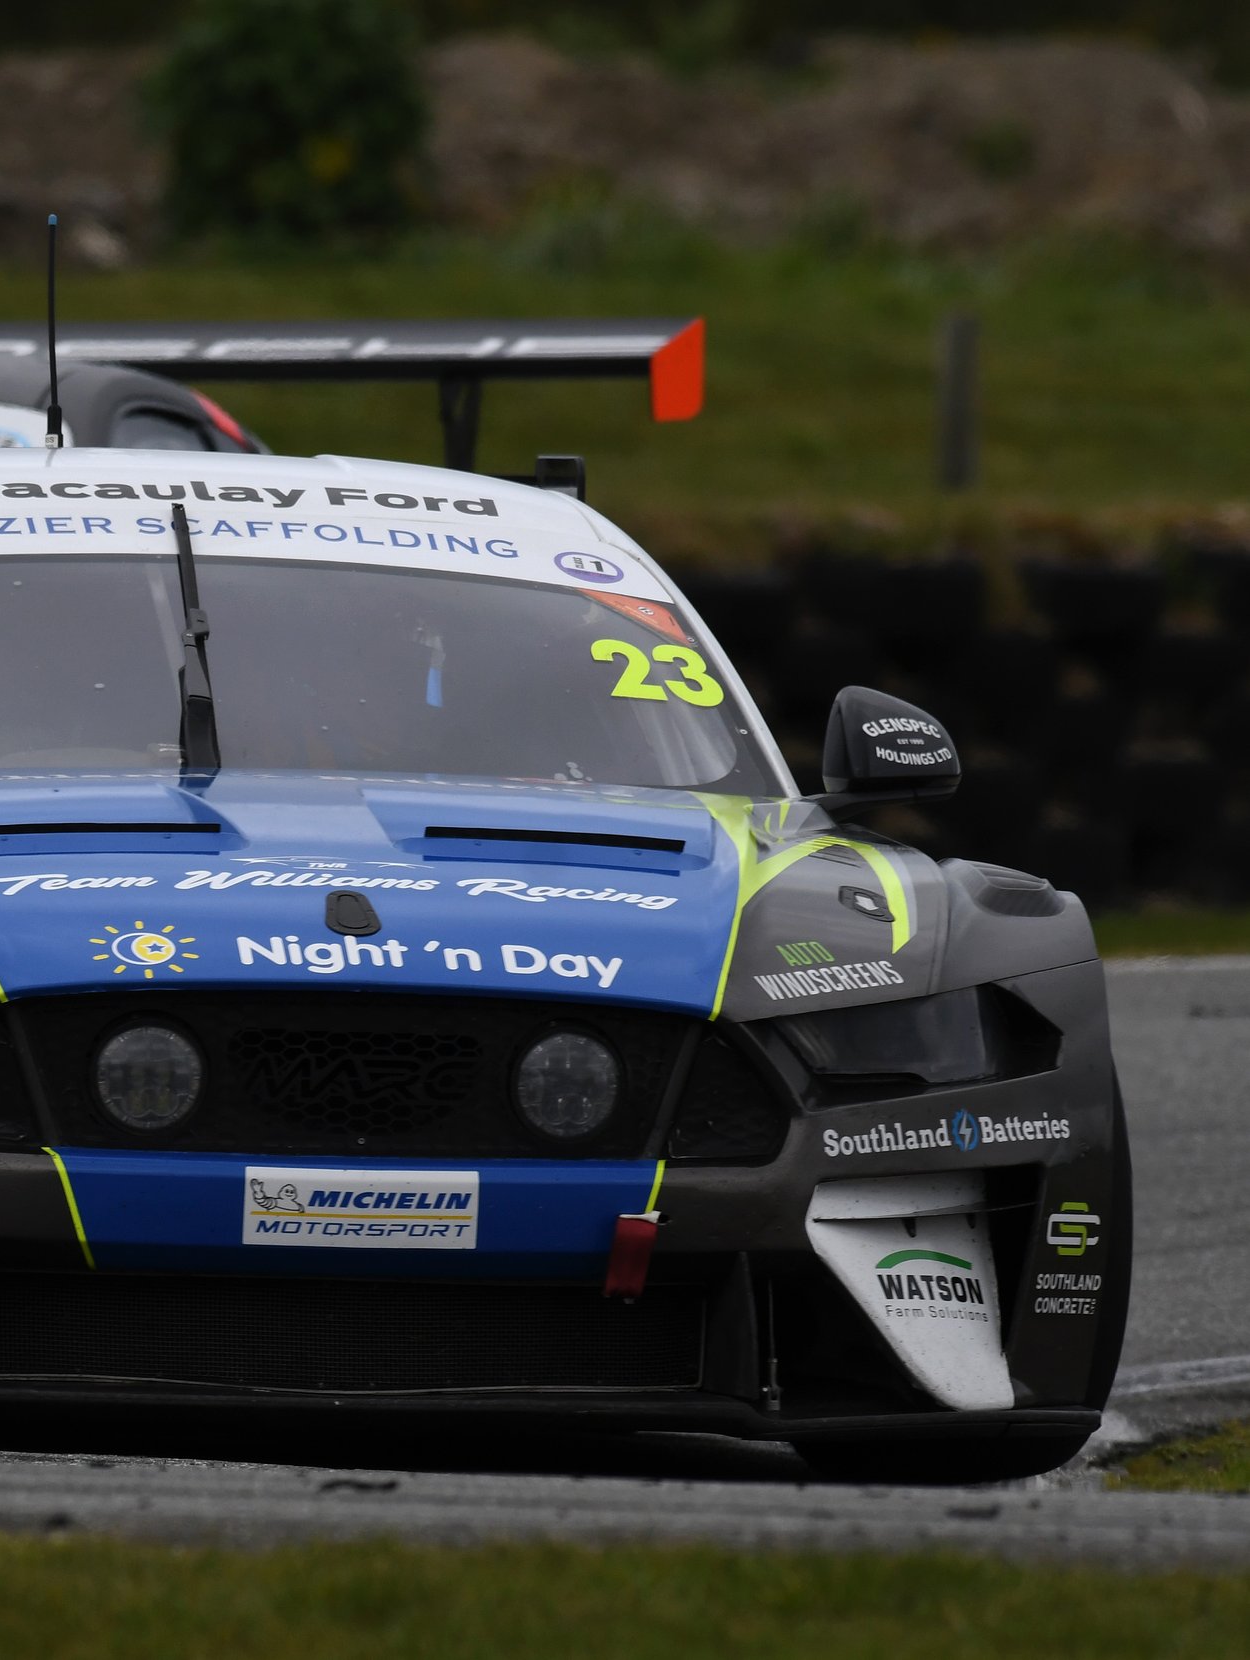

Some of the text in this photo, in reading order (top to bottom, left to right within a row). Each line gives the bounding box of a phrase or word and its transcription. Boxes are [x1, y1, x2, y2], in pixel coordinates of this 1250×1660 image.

[325, 487, 499, 517] Ford
[591, 639, 724, 707] 23
[862, 718, 941, 739] GLENSPEC
[875, 746, 952, 765] HOLDINGS LTD
[173, 870, 440, 890] Williams
[456, 878, 678, 910] Racing
[236, 935, 408, 974] Night
[501, 944, 623, 988] Day
[776, 941, 835, 967] AUTO
[754, 960, 904, 1001] WINDSCREENS
[823, 1112, 1070, 1158] Southland Batteries
[308, 1190, 472, 1210] MICHELIN
[256, 1220, 470, 1237] MOTORSPORT
[877, 1274, 984, 1304] WATSON
[1036, 1273, 1101, 1290] SOUTHLAND
[885, 1304, 988, 1322] Farm Solutions
[1034, 1297, 1092, 1314] CONCRETE
